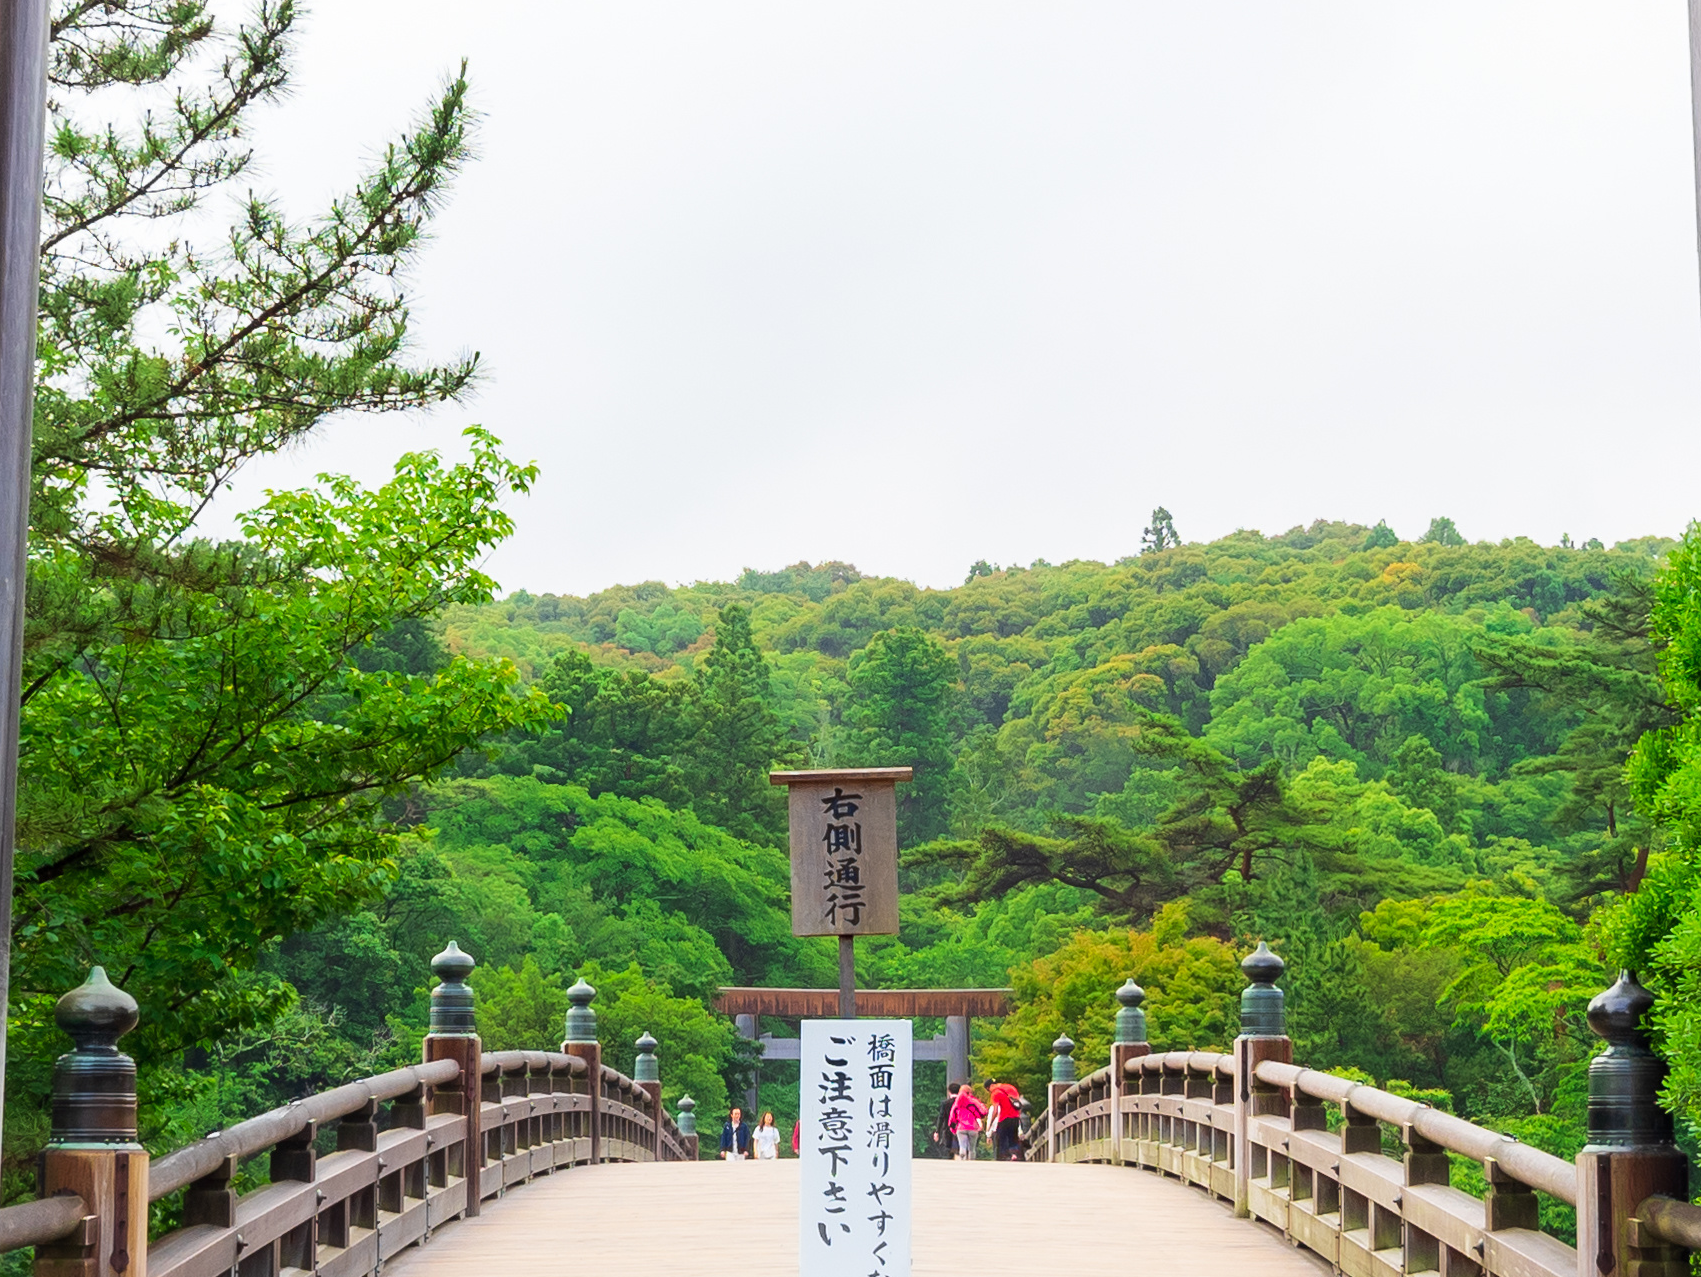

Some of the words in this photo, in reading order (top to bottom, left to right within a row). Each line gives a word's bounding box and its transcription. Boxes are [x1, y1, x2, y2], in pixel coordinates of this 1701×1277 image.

[820, 787, 867, 926] 右側通行
[817, 1035, 857, 1247] ご注意下さい
